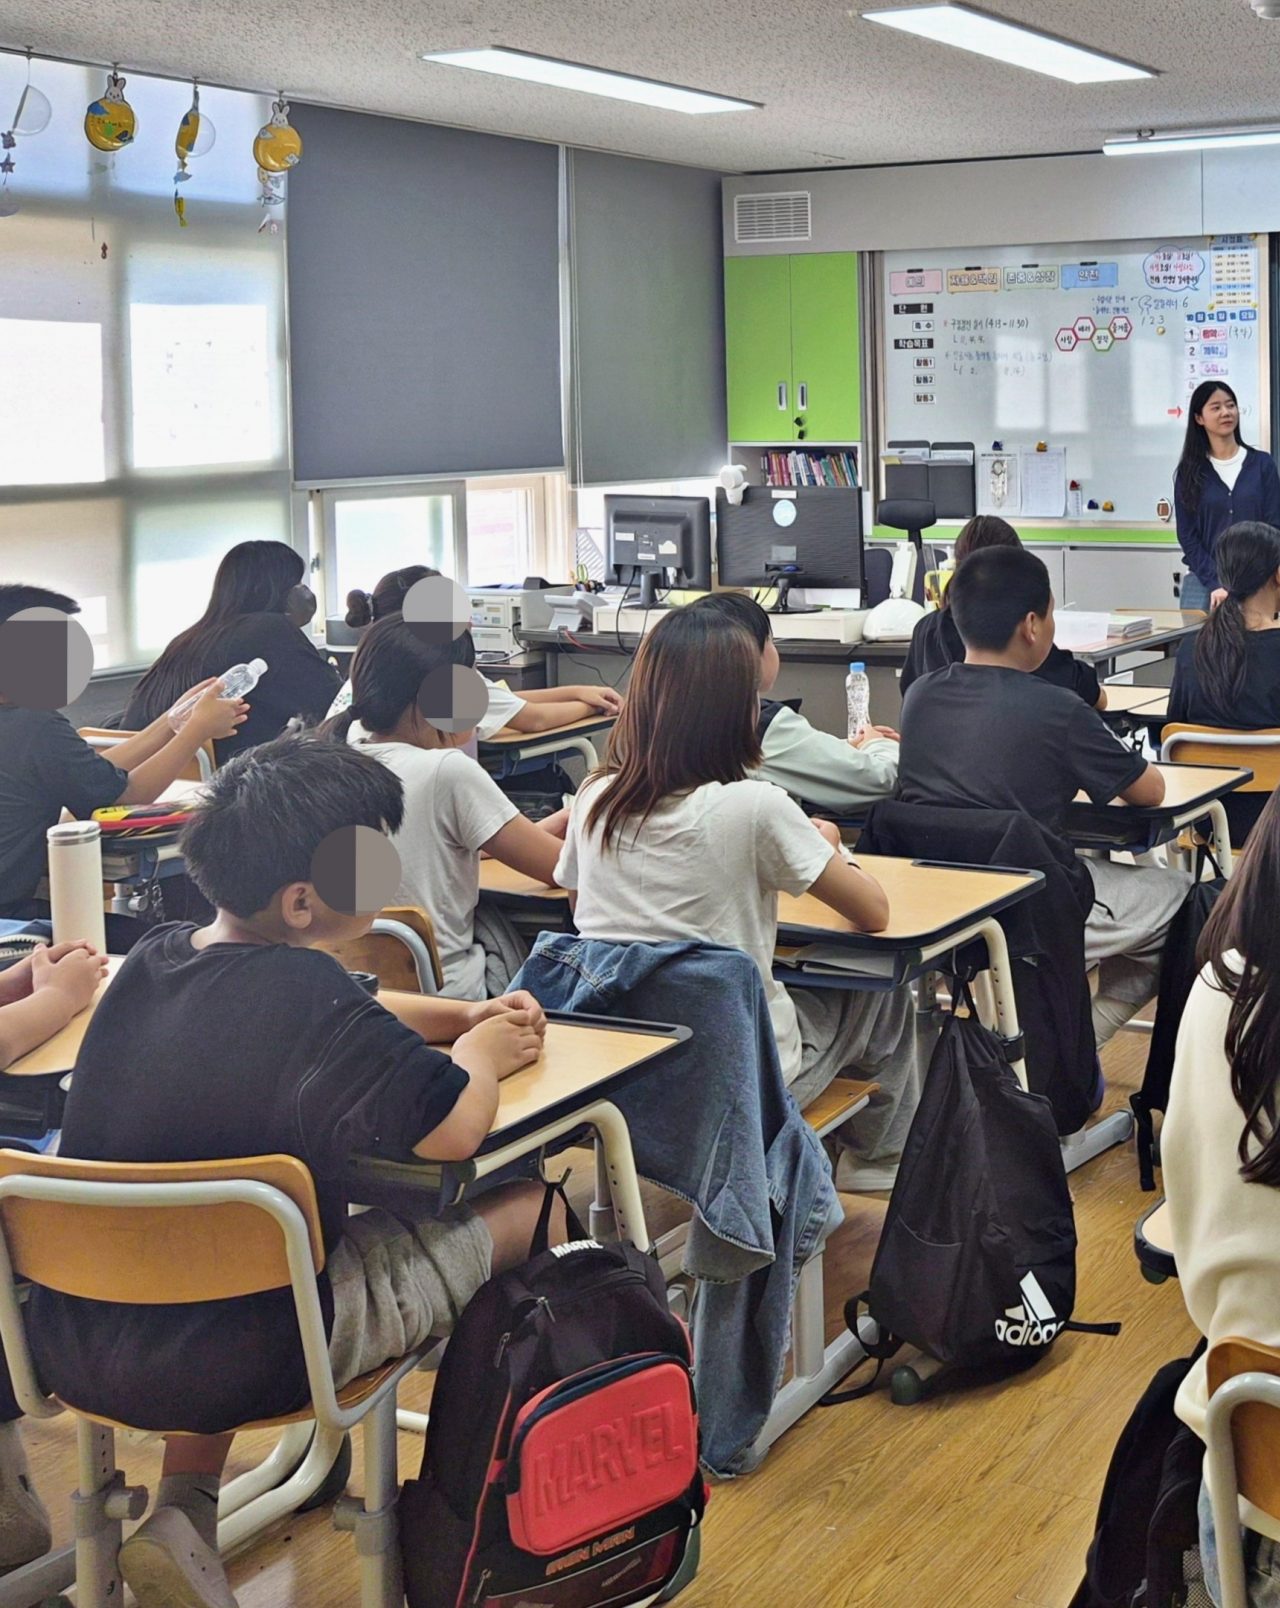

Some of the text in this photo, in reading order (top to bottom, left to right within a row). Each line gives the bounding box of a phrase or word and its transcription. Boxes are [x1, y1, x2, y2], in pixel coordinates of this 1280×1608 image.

[1078, 268, 1099, 281] 안전
[899, 339, 928, 349] 학습목표
[1189, 346, 1195, 356] 2
[915, 359, 933, 367] 활동1
[915, 375, 933, 384] 활동2
[915, 394, 934, 402] 활동3
[549, 1240, 604, 1258] MARVEL
[534, 1401, 684, 1518] MARVEL
